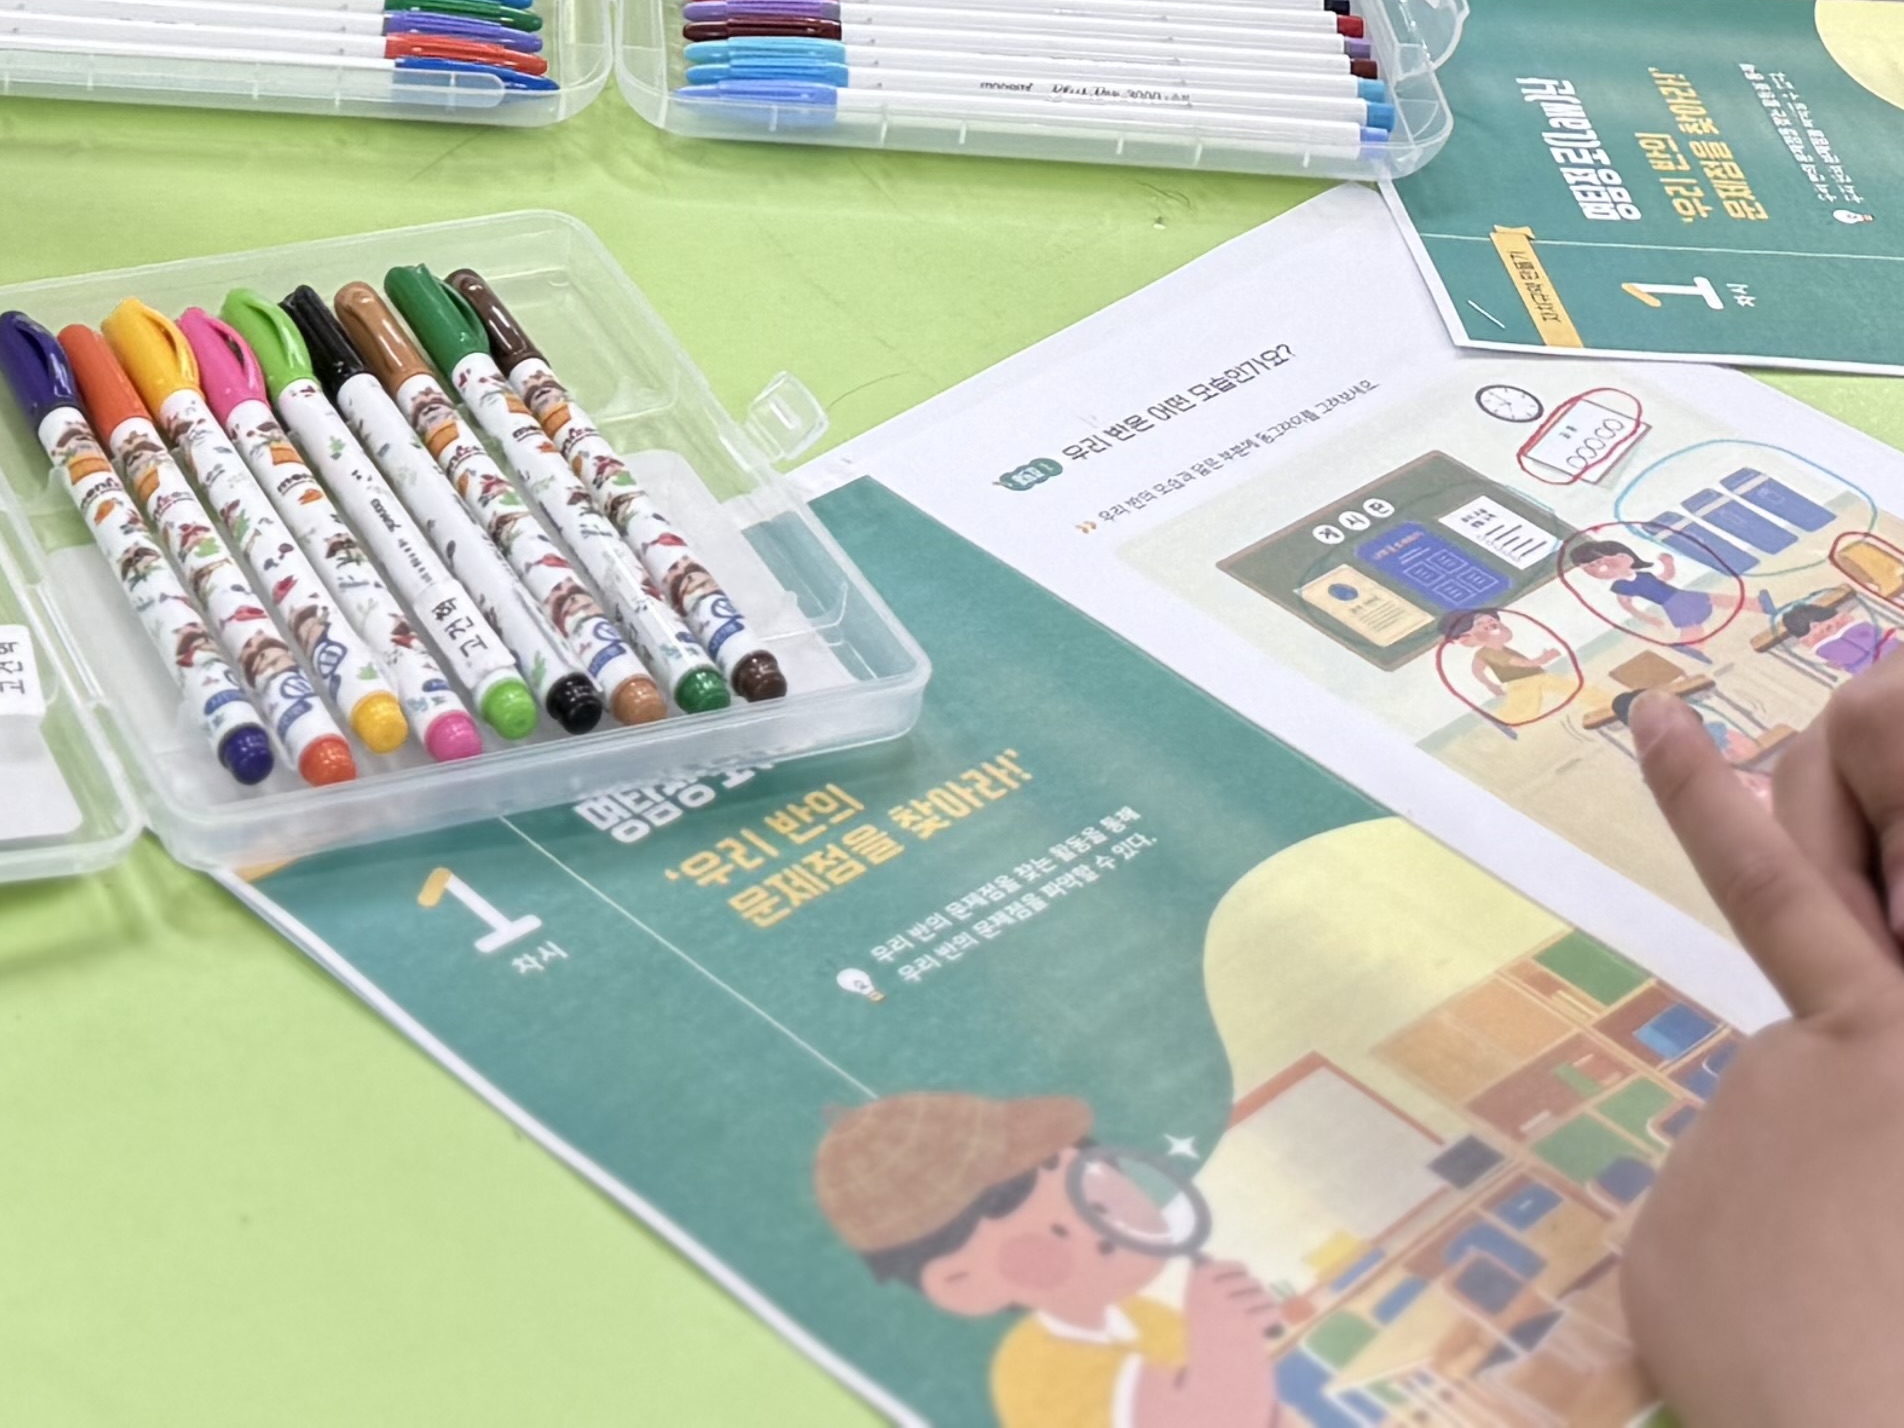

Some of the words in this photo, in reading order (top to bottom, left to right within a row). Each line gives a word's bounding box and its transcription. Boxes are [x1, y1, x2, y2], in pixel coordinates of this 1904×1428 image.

[1635, 132, 1691, 171] 반의
[1689, 140, 1769, 221] 문제점을
[1559, 167, 1642, 221] 명탐정
[1621, 276, 1725, 310] 1
[1062, 435, 1113, 461] 우리
[1104, 414, 1155, 442] 반은
[1146, 394, 1197, 422] 어떤
[1187, 343, 1296, 404] 모습인가요?
[764, 782, 866, 845] 반의
[417, 866, 543, 953] 1
[728, 823, 905, 928] 문제점을
[870, 934, 915, 963] 우리
[906, 912, 953, 942] 반의
[944, 874, 1022, 920] 문제점을
[1013, 856, 1058, 883] 찾는
[1049, 826, 1109, 863] 활동을
[1099, 805, 1142, 834] 통해
[511, 940, 568, 974] 차시
[897, 954, 943, 984] 우리
[934, 931, 980, 961] 반의
[972, 892, 1049, 940] 문제점을
[1038, 863, 1101, 898] 파악할
[1095, 853, 1117, 871] 수
